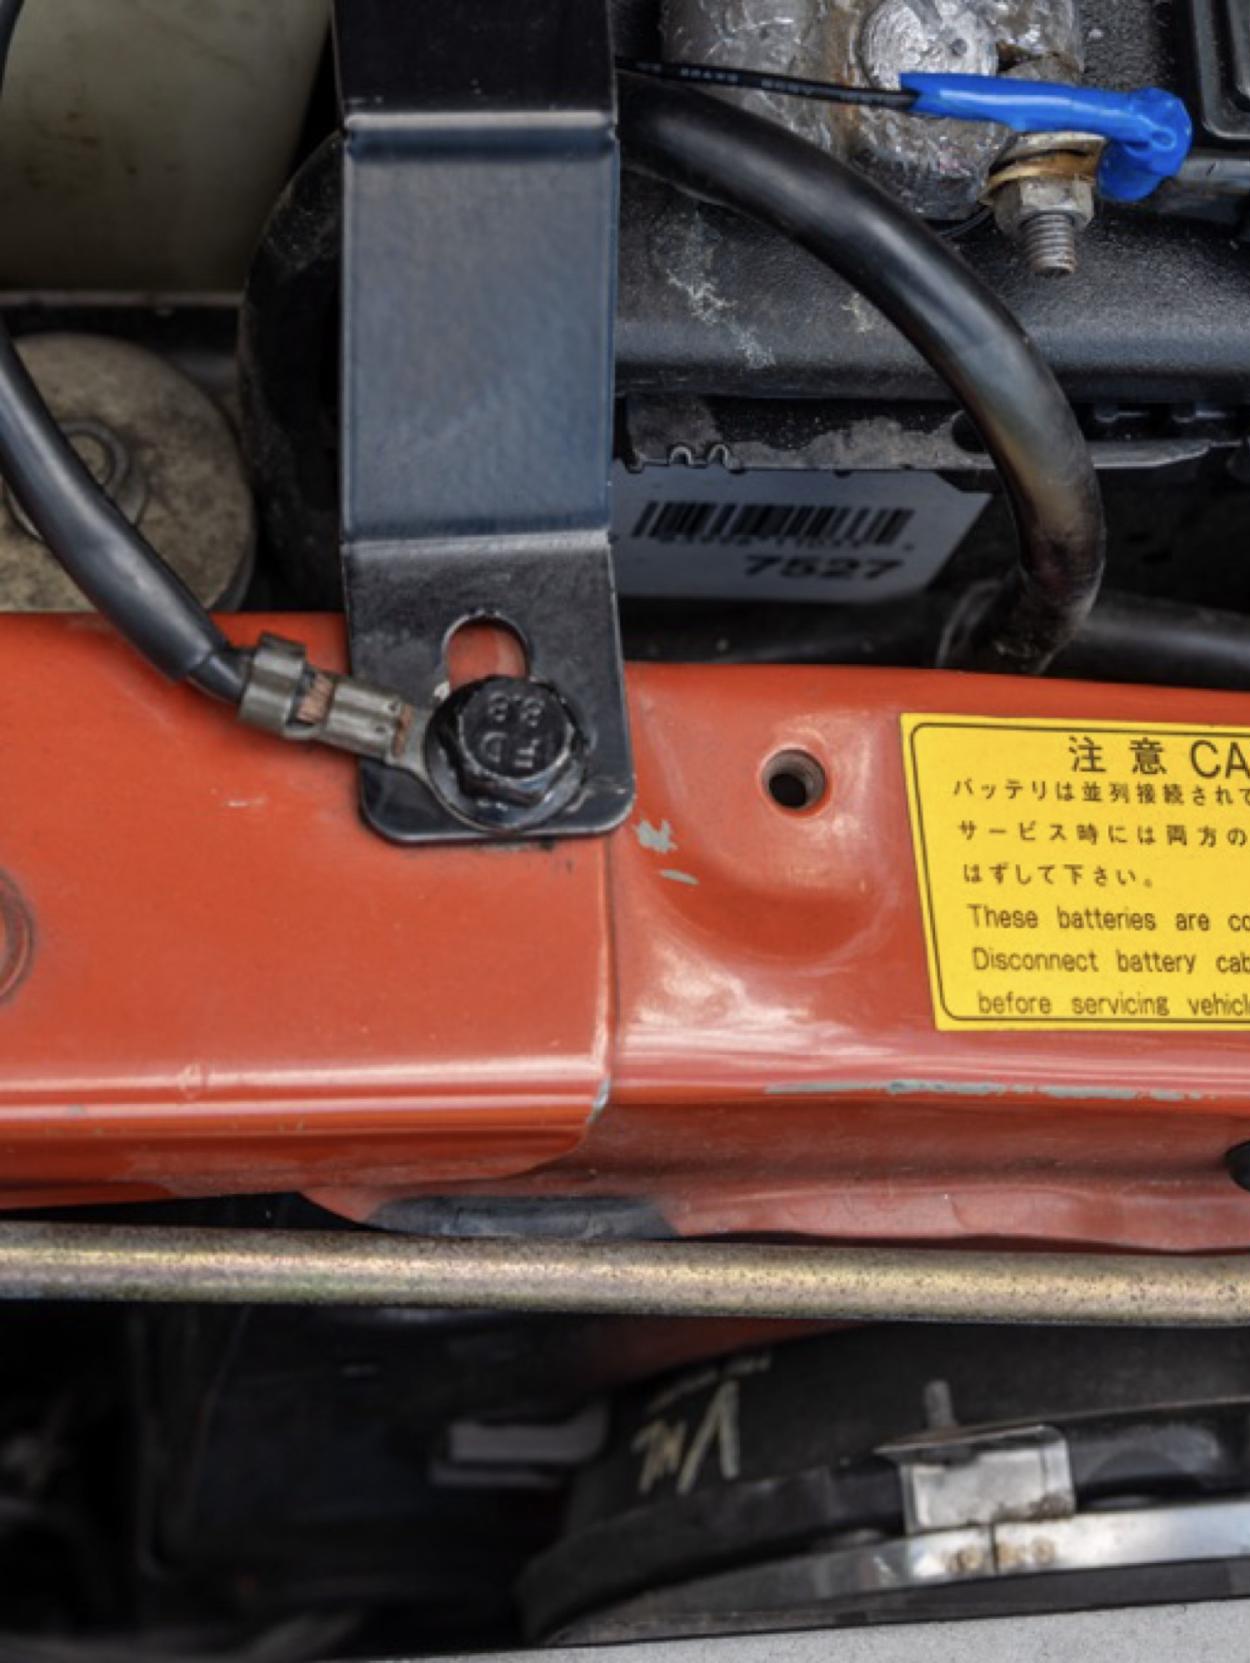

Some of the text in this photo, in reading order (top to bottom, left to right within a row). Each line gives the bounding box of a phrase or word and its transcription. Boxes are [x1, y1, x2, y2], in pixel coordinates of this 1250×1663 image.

[962, 863, 1154, 888] はずして下さい。
[966, 903, 1039, 929] These
[1056, 905, 1157, 932] batteries
[1174, 912, 1211, 932] are
[971, 946, 1099, 973] Disconnect
[1116, 949, 1197, 976] battery
[976, 990, 1052, 1016] before
[1070, 991, 1171, 1017] servicing
